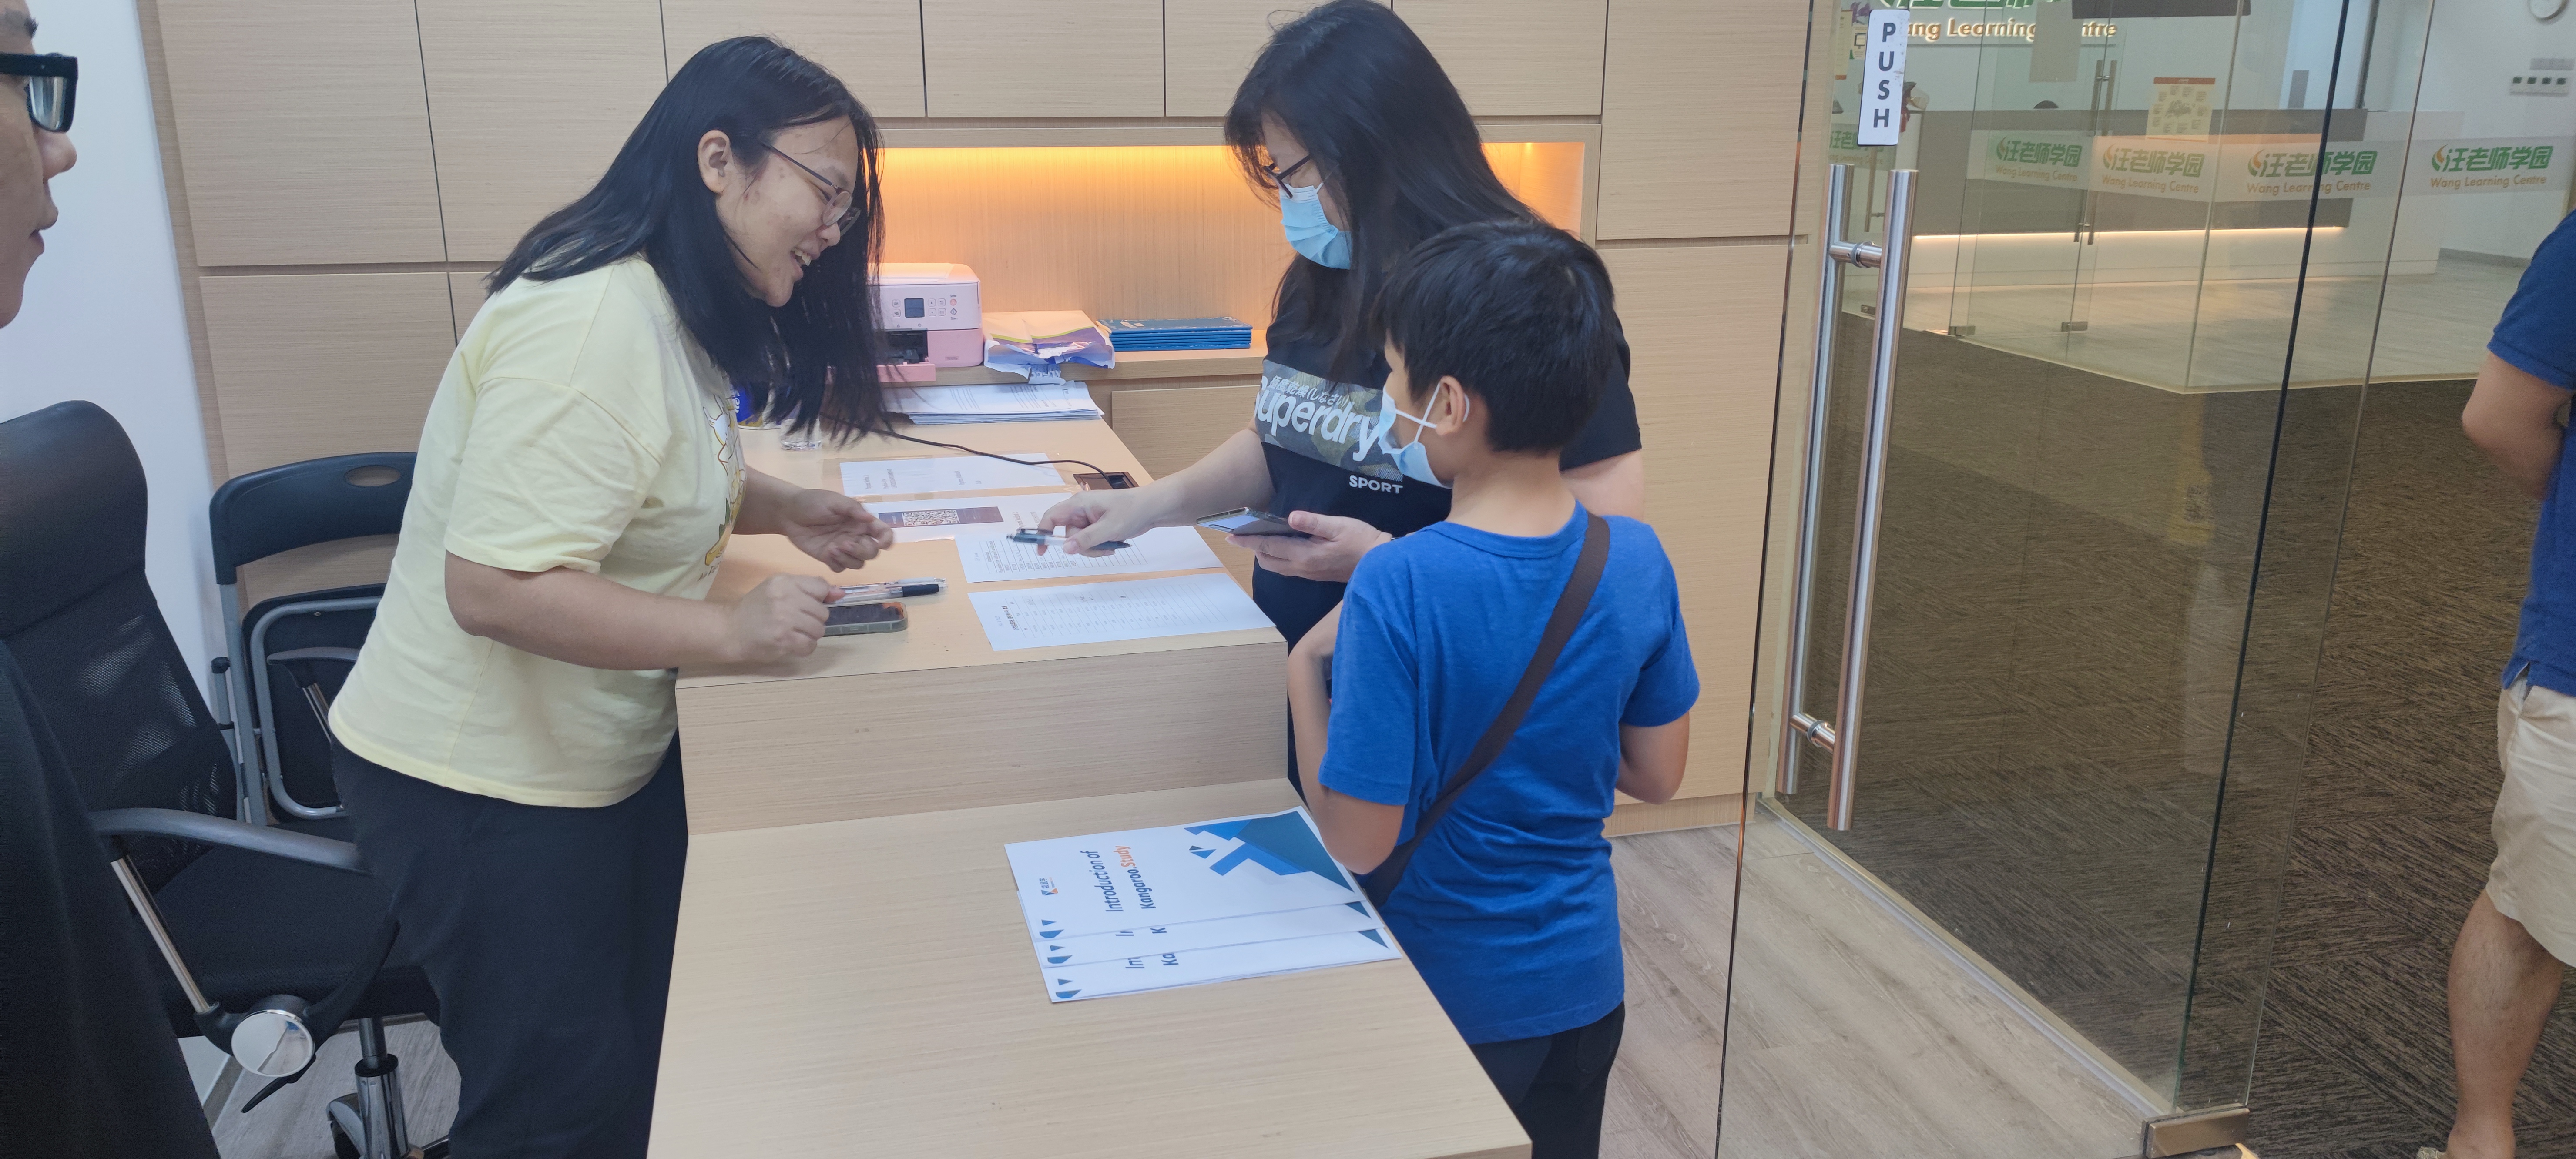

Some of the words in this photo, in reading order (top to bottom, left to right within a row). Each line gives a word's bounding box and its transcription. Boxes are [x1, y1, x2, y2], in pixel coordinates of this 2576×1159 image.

[1873, 22, 1896, 128] PUSH
[2003, 140, 2083, 167] 汪老师学园
[2111, 148, 2205, 178] 汪老师学园
[2442, 145, 2554, 172] 汪老师学园
[2102, 175, 2126, 189] Wang
[2128, 177, 2167, 193] Learning
[2169, 181, 2199, 194] Centre
[2247, 183, 2280, 196] Wang
[2283, 182, 2332, 194] Learnng
[2336, 180, 2371, 192] Centre
[2431, 177, 2461, 190] Wang
[2464, 175, 2510, 188] Learning
[2513, 174, 2546, 185] Centre
[1349, 475, 1403, 494] SPORT
[1079, 850, 1100, 859] of
[1088, 860, 1124, 912] Introduction
[1113, 845, 1156, 909] Kangaroo.study
